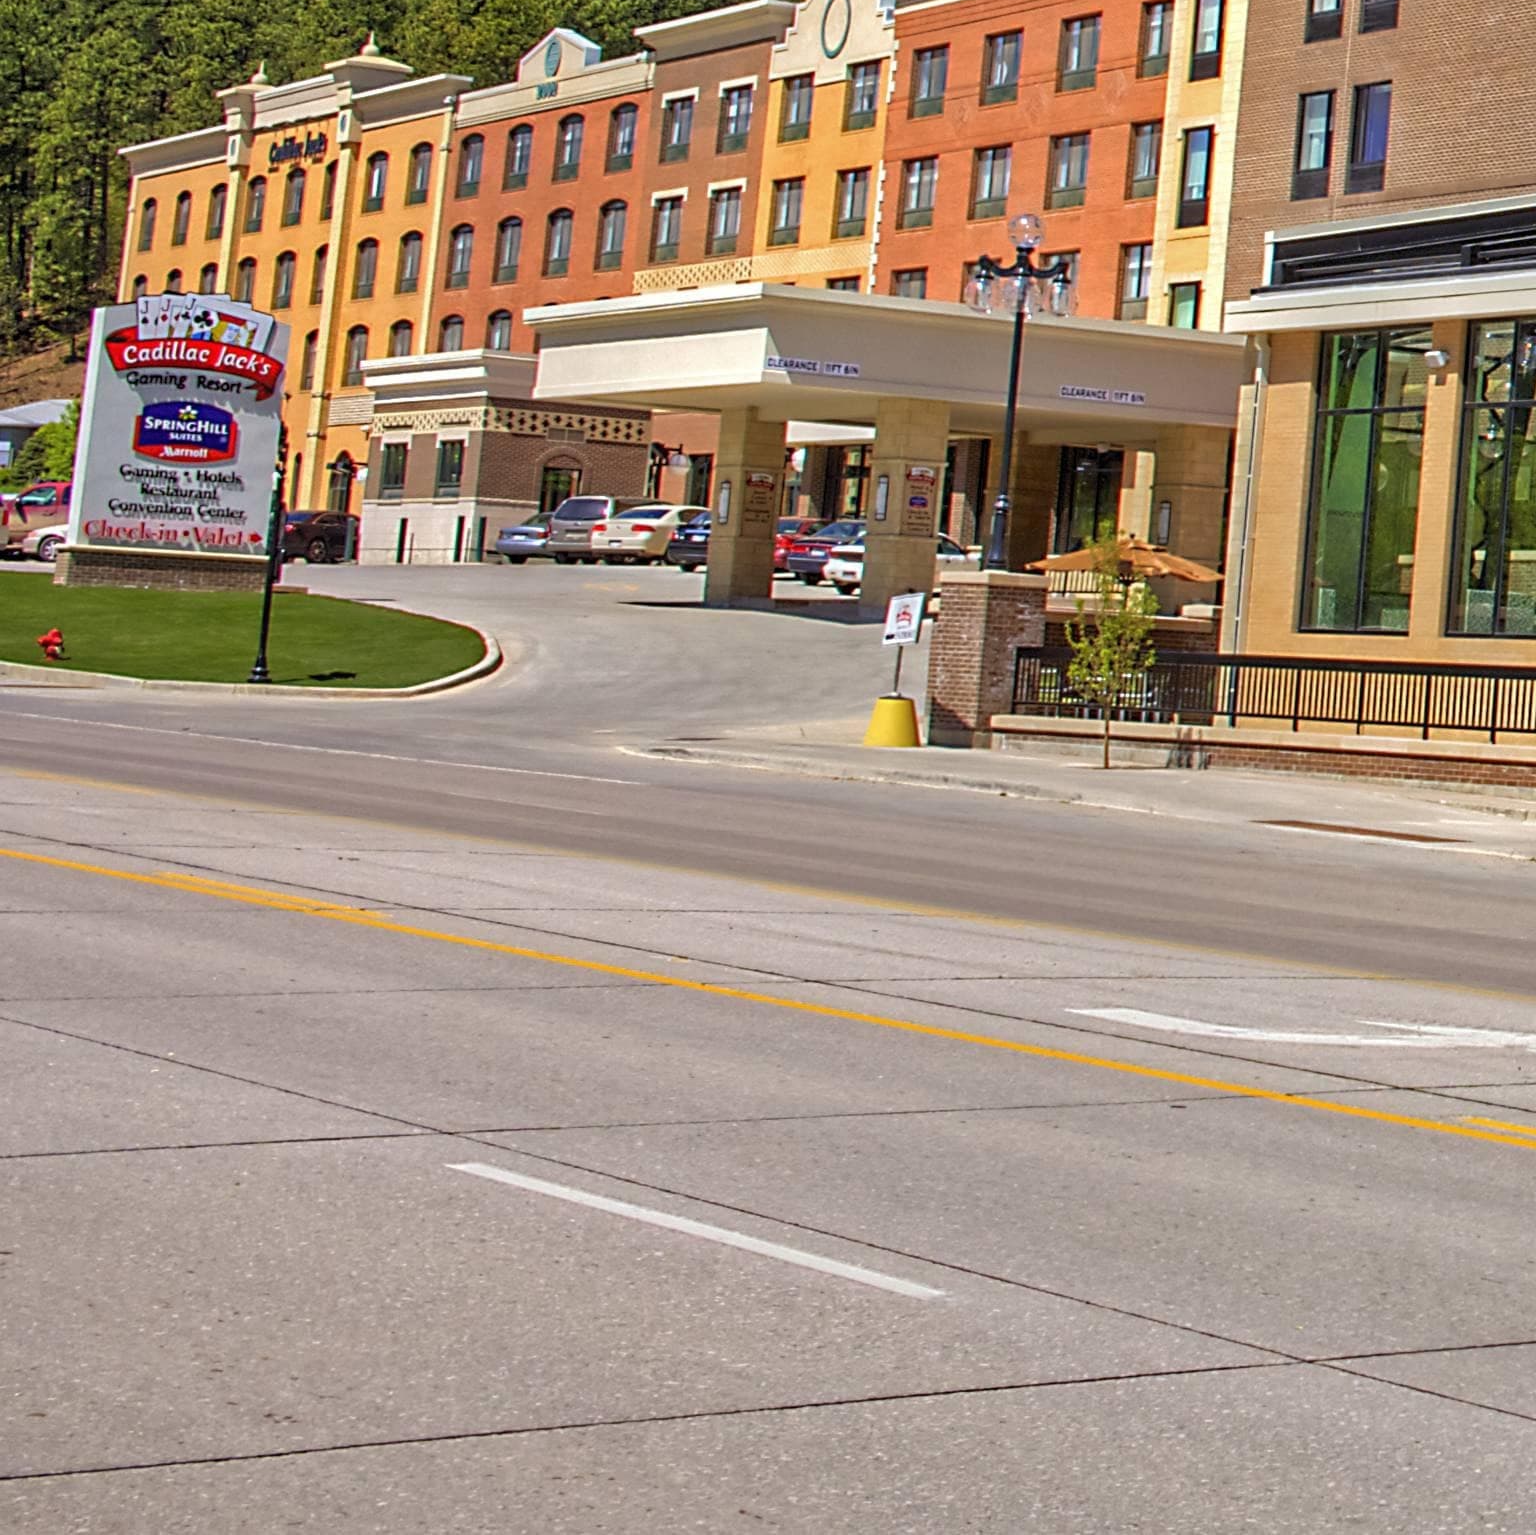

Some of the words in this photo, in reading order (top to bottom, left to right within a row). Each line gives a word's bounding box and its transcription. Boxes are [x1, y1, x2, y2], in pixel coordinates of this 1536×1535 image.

[123, 340, 211, 364] Cadillac
[215, 344, 272, 375] Jack's
[767, 357, 818, 371] CLEARANCE
[126, 371, 187, 390] Gaming
[197, 375, 242, 394] Resort
[1061, 386, 1107, 400] CLEARANCE
[144, 416, 228, 435] SPRINGHILL
[168, 432, 203, 442] SUITES
[119, 463, 178, 483] Gaming
[196, 469, 243, 485] Hotels
[140, 482, 218, 501] Restaurant
[108, 497, 193, 516] Convention
[196, 503, 246, 519] Center
[84, 519, 179, 543] Check-in
[192, 525, 243, 546] Valet
